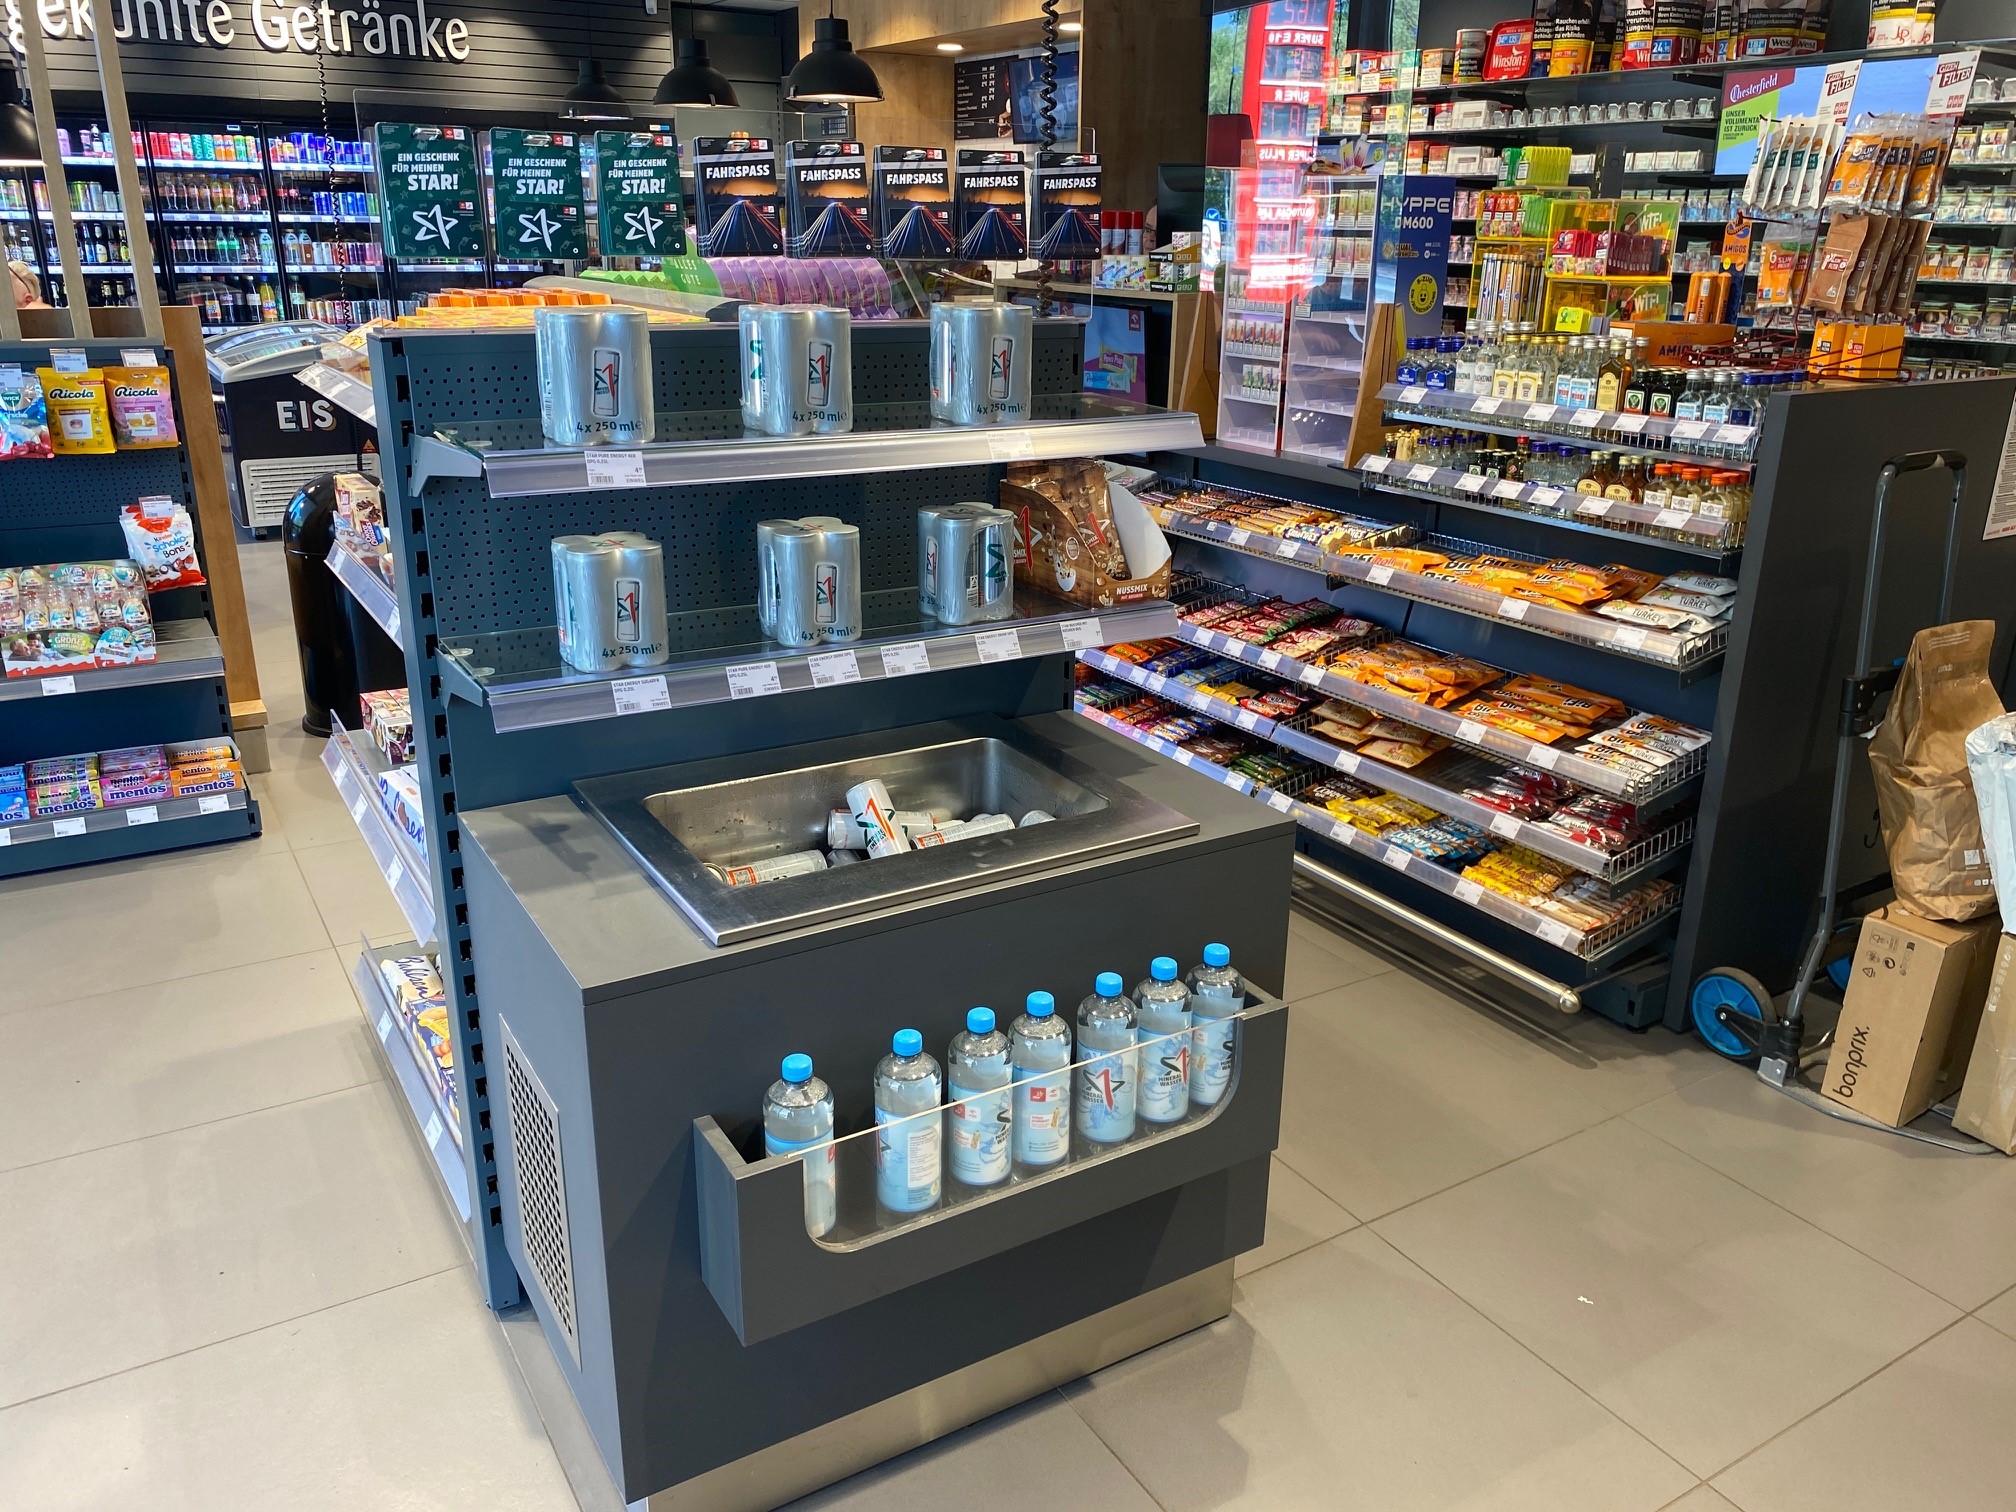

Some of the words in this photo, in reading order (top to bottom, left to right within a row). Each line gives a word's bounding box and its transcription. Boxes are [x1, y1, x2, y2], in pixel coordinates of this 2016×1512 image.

[1626, 9, 1651, 17] Rauchen
[252, 0, 470, 60] Getränke
[1771, 37, 1792, 48] West
[1492, 54, 1522, 69] Winston
[1943, 68, 1971, 87] FILTER
[1730, 73, 1778, 103] Chesterfield
[1830, 78, 1855, 95] FILTER
[1725, 110, 1746, 118] UNSER
[398, 153, 412, 162] EIN
[414, 153, 459, 162] GESCHENK
[508, 158, 522, 167] EIN
[524, 158, 567, 167] GESCHENK
[613, 159, 627, 168] EIN
[628, 158, 667, 168] GESCHENK
[392, 163, 410, 173] FÜR
[411, 163, 444, 173] MEINEN
[502, 168, 518, 177] FÜR
[520, 168, 552, 178] MEINEN
[608, 169, 624, 178] FÜR
[624, 169, 653, 178] MEINEN
[706, 164, 770, 179] FAHRSPASS
[800, 168, 861, 182] FAHRSPASS
[886, 173, 944, 185] FAHRSPASS
[964, 175, 1019, 188] FAHRSPASS
[408, 174, 459, 191] STAR!
[516, 179, 564, 195] STAR!
[621, 178, 666, 195] STAR!
[1043, 176, 1097, 190] FAHRSPASS
[1380, 196, 1451, 213] HYPPE
[1394, 216, 1434, 229] DM600
[1639, 212, 1663, 232] WTF!
[1724, 245, 1747, 254] AMIGOS
[1769, 249, 1777, 264] 6
[673, 257, 697, 271] ALLES
[680, 273, 701, 286] GUTE
[1634, 291, 1659, 314] WTF!
[50, 388, 95, 399] Ricola
[114, 386, 158, 397] Ricola
[976, 404, 988, 415] 4x
[990, 403, 1006, 412] 250
[276, 400, 338, 432] EIS
[793, 411, 805, 422] 4x
[807, 411, 825, 420] 250
[576, 421, 592, 433] 4x
[595, 421, 617, 431] 250
[152, 535, 188, 553] Schoko-
[162, 545, 186, 558] Bons
[1116, 583, 1148, 596] NUSSMIX
[1694, 577, 1722, 590] TURKEY
[1679, 596, 1711, 610] TURKEY
[1632, 608, 1663, 623] TURKEY
[801, 630, 815, 641] 4x
[817, 626, 834, 637] 250
[602, 648, 616, 658] 4x
[618, 645, 639, 654] 250
[1663, 736, 1685, 747] TURKEY
[1633, 749, 1656, 761] TURKEY
[1622, 758, 1647, 770] TURKEY
[1618, 765, 1640, 778] TURKEY
[33, 774, 73, 785] mentos
[109, 784, 167, 800] mentos
[180, 780, 235, 795] mentos
[37, 799, 97, 815] mentos
[1158, 1073, 1182, 1082] MINERAL
[1160, 1078, 1182, 1087] WASSER
[1082, 1089, 1103, 1099] MINERAL
[1083, 1094, 1104, 1104] WASSER
